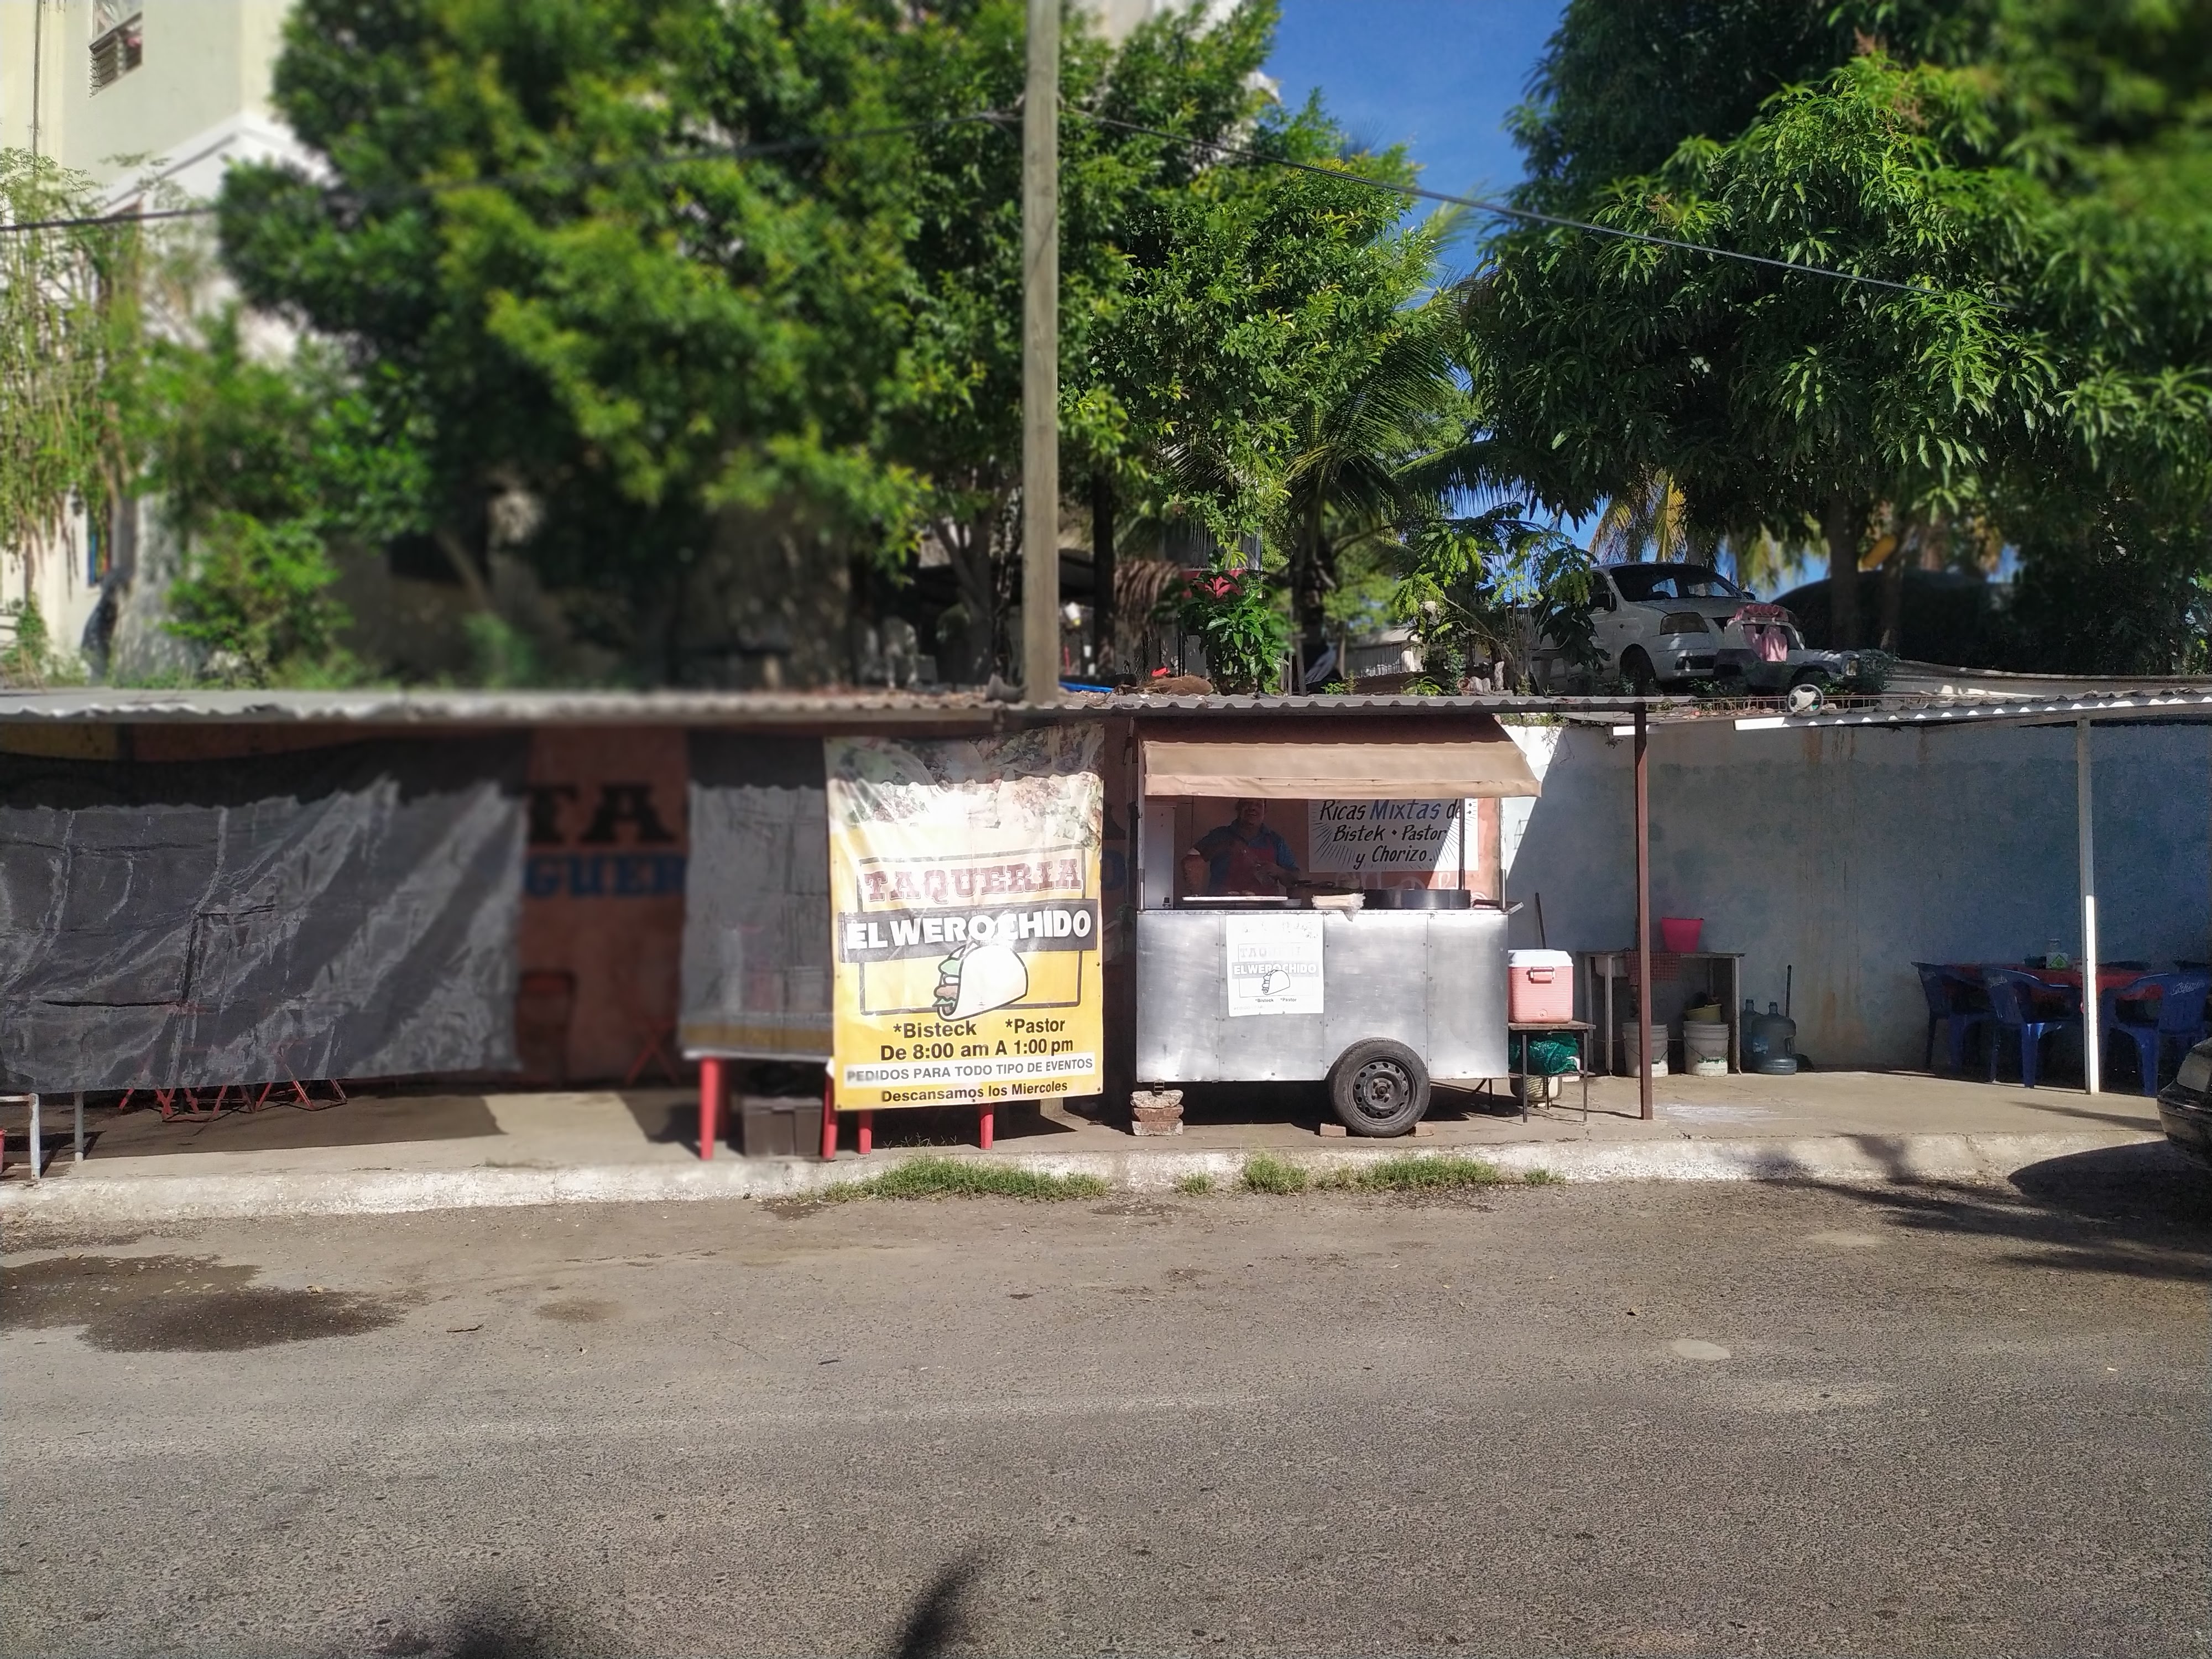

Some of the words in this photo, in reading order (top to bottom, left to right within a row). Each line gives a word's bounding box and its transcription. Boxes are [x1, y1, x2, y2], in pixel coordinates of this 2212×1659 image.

[1319, 799, 1366, 820] Ricas
[1369, 799, 1441, 820] Mixtas
[1333, 825, 1386, 842] Bistek
[1401, 824, 1447, 841] Pastor
[1353, 852, 1366, 870] y
[864, 858, 1083, 904] TAQUERIA
[847, 922, 888, 949] EL
[890, 915, 995, 946] WERO
[994, 910, 1091, 941] CHIDO
[1234, 965, 1247, 974] EL
[1282, 963, 1317, 973] CHIDO
[880, 1045, 906, 1061] De
[913, 1042, 953, 1059] 8:00
[961, 1044, 989, 1057] am
[995, 1041, 1008, 1056] A
[1014, 1039, 1047, 1054] 1:00
[1051, 1039, 1073, 1056] pm
[847, 1068, 910, 1082] PEDIDOS
[914, 1067, 951, 1079] PARA
[955, 1065, 993, 1077] TODO
[996, 1063, 1024, 1074] TIPO
[1027, 1061, 1043, 1073] DE
[1046, 1058, 1093, 1072] EVENTOS
[883, 1089, 984, 1102] Descansamos
[988, 1086, 1007, 1097] los
[1011, 1081, 1068, 1095] Miercoles
